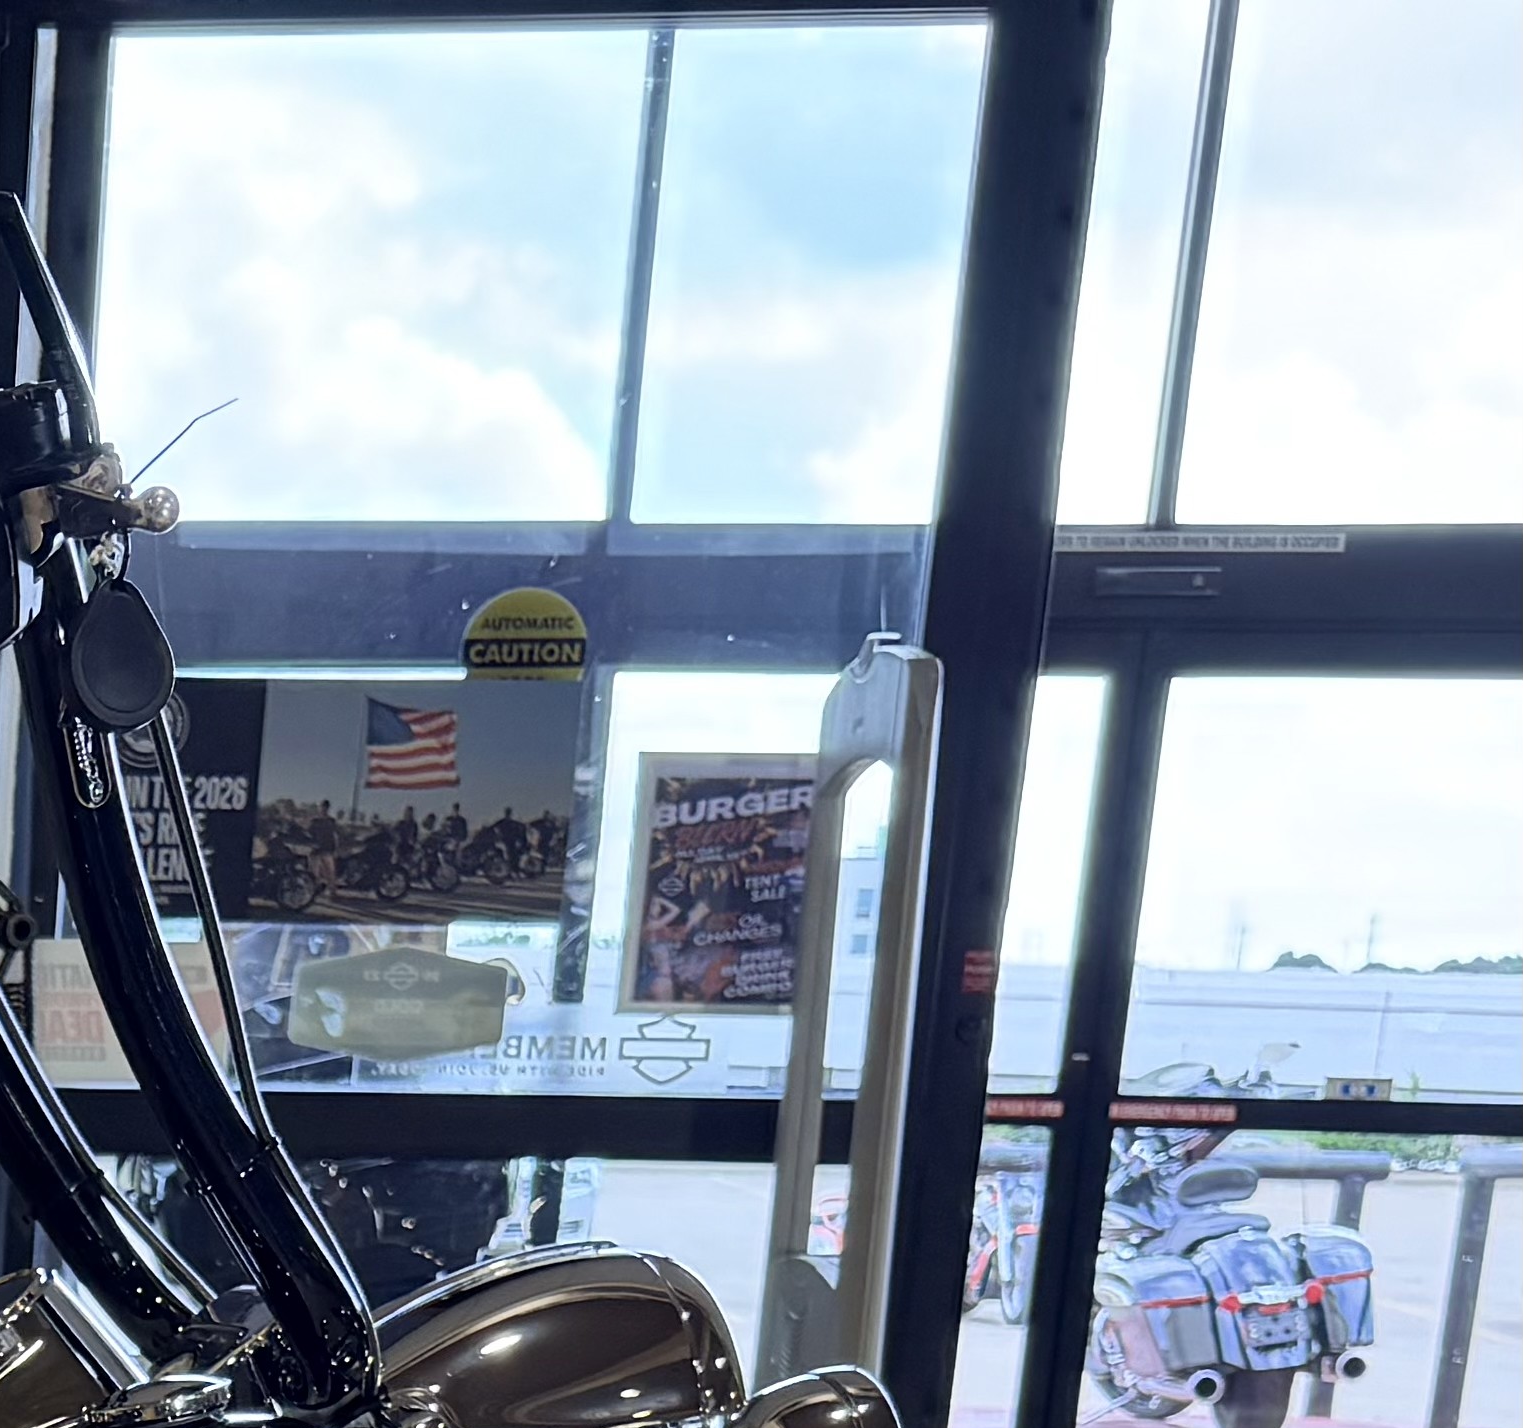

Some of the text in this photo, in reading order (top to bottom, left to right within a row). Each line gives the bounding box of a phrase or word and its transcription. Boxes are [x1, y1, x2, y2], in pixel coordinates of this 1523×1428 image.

[480, 616, 576, 631] AUTOMATIC
[469, 642, 582, 664] CAUTION
[193, 776, 249, 811] 2026
[655, 785, 814, 829] BURGER
[693, 922, 783, 947] CHANGES
